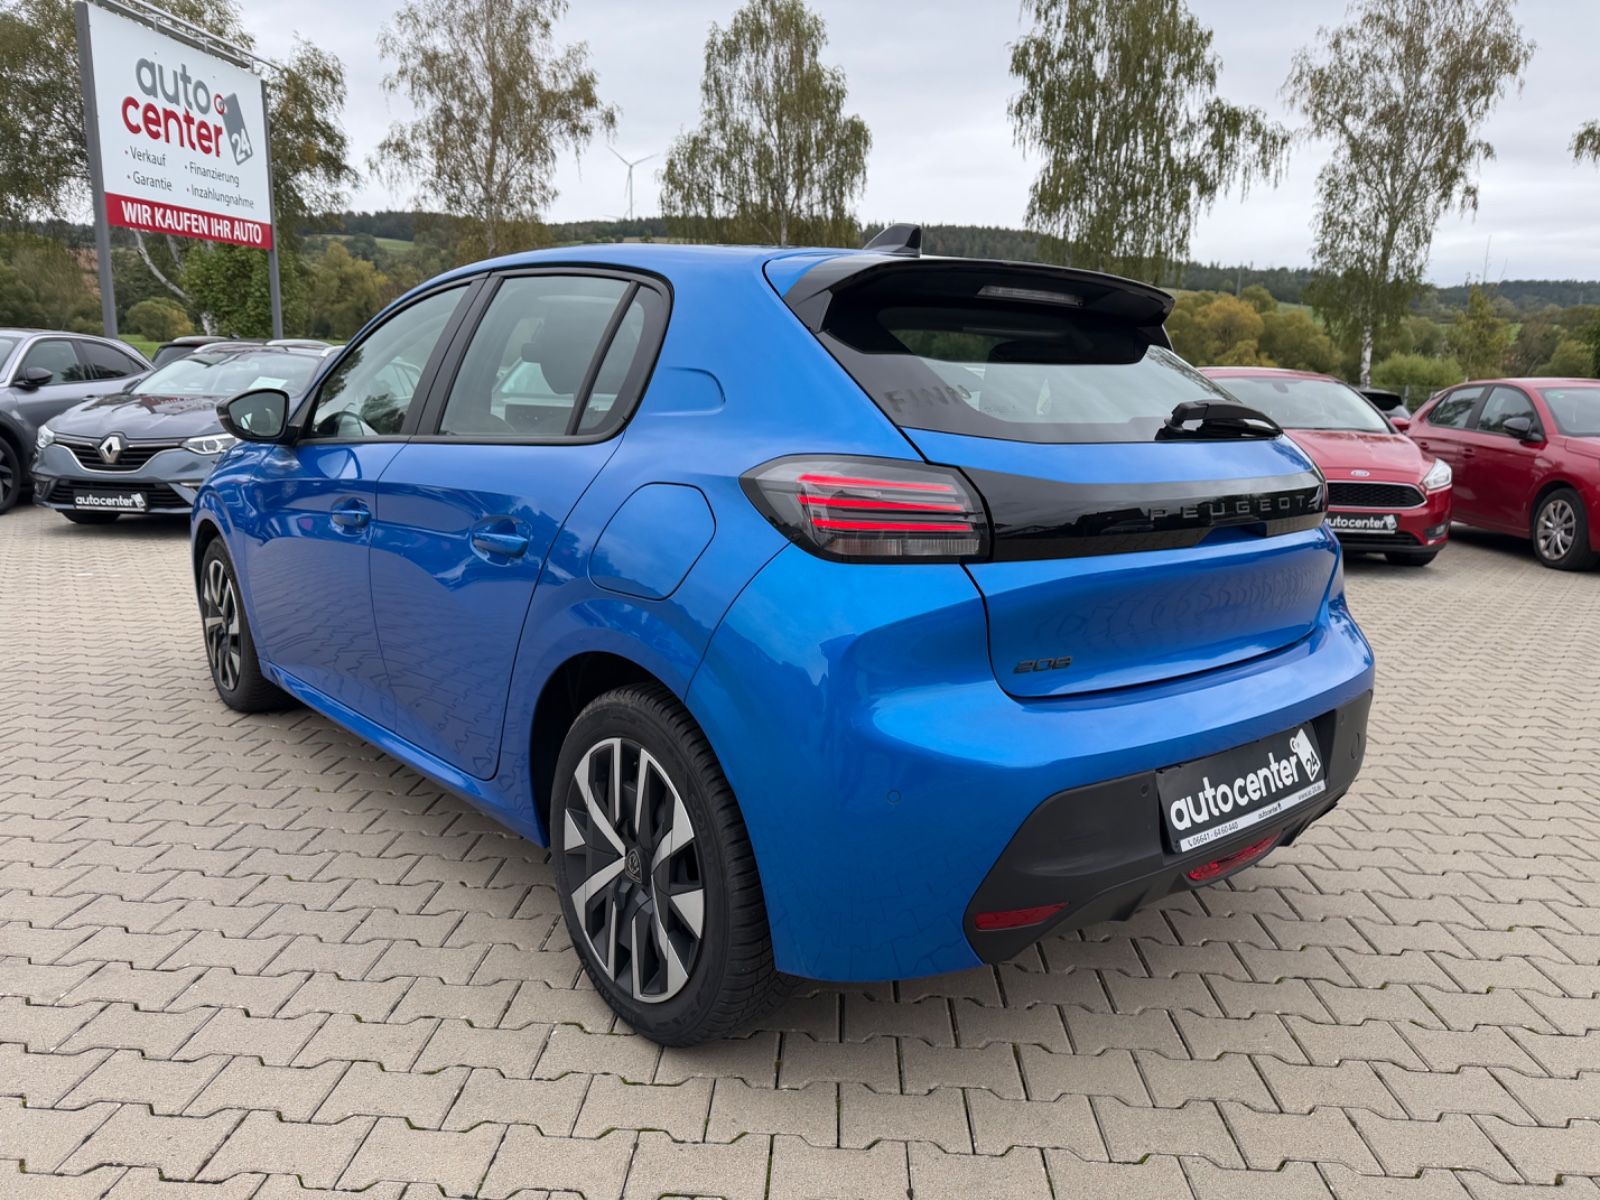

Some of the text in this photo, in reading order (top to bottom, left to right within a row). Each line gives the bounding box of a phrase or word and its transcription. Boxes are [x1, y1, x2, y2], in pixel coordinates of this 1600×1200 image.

[135, 57, 211, 115] auto
[121, 96, 223, 158] center
[130, 146, 166, 167] Verkauf
[231, 129, 250, 160] 24
[132, 171, 173, 192] Garantie
[189, 161, 240, 188] Finanzierung
[191, 184, 255, 209] Inzahlungnahme
[121, 200, 262, 244] WIR KAUFEN IHR AUTO
[75, 494, 133, 506] autocenter
[1151, 495, 1306, 521] PEUGEOT
[1170, 751, 1319, 831] autocenter 24
